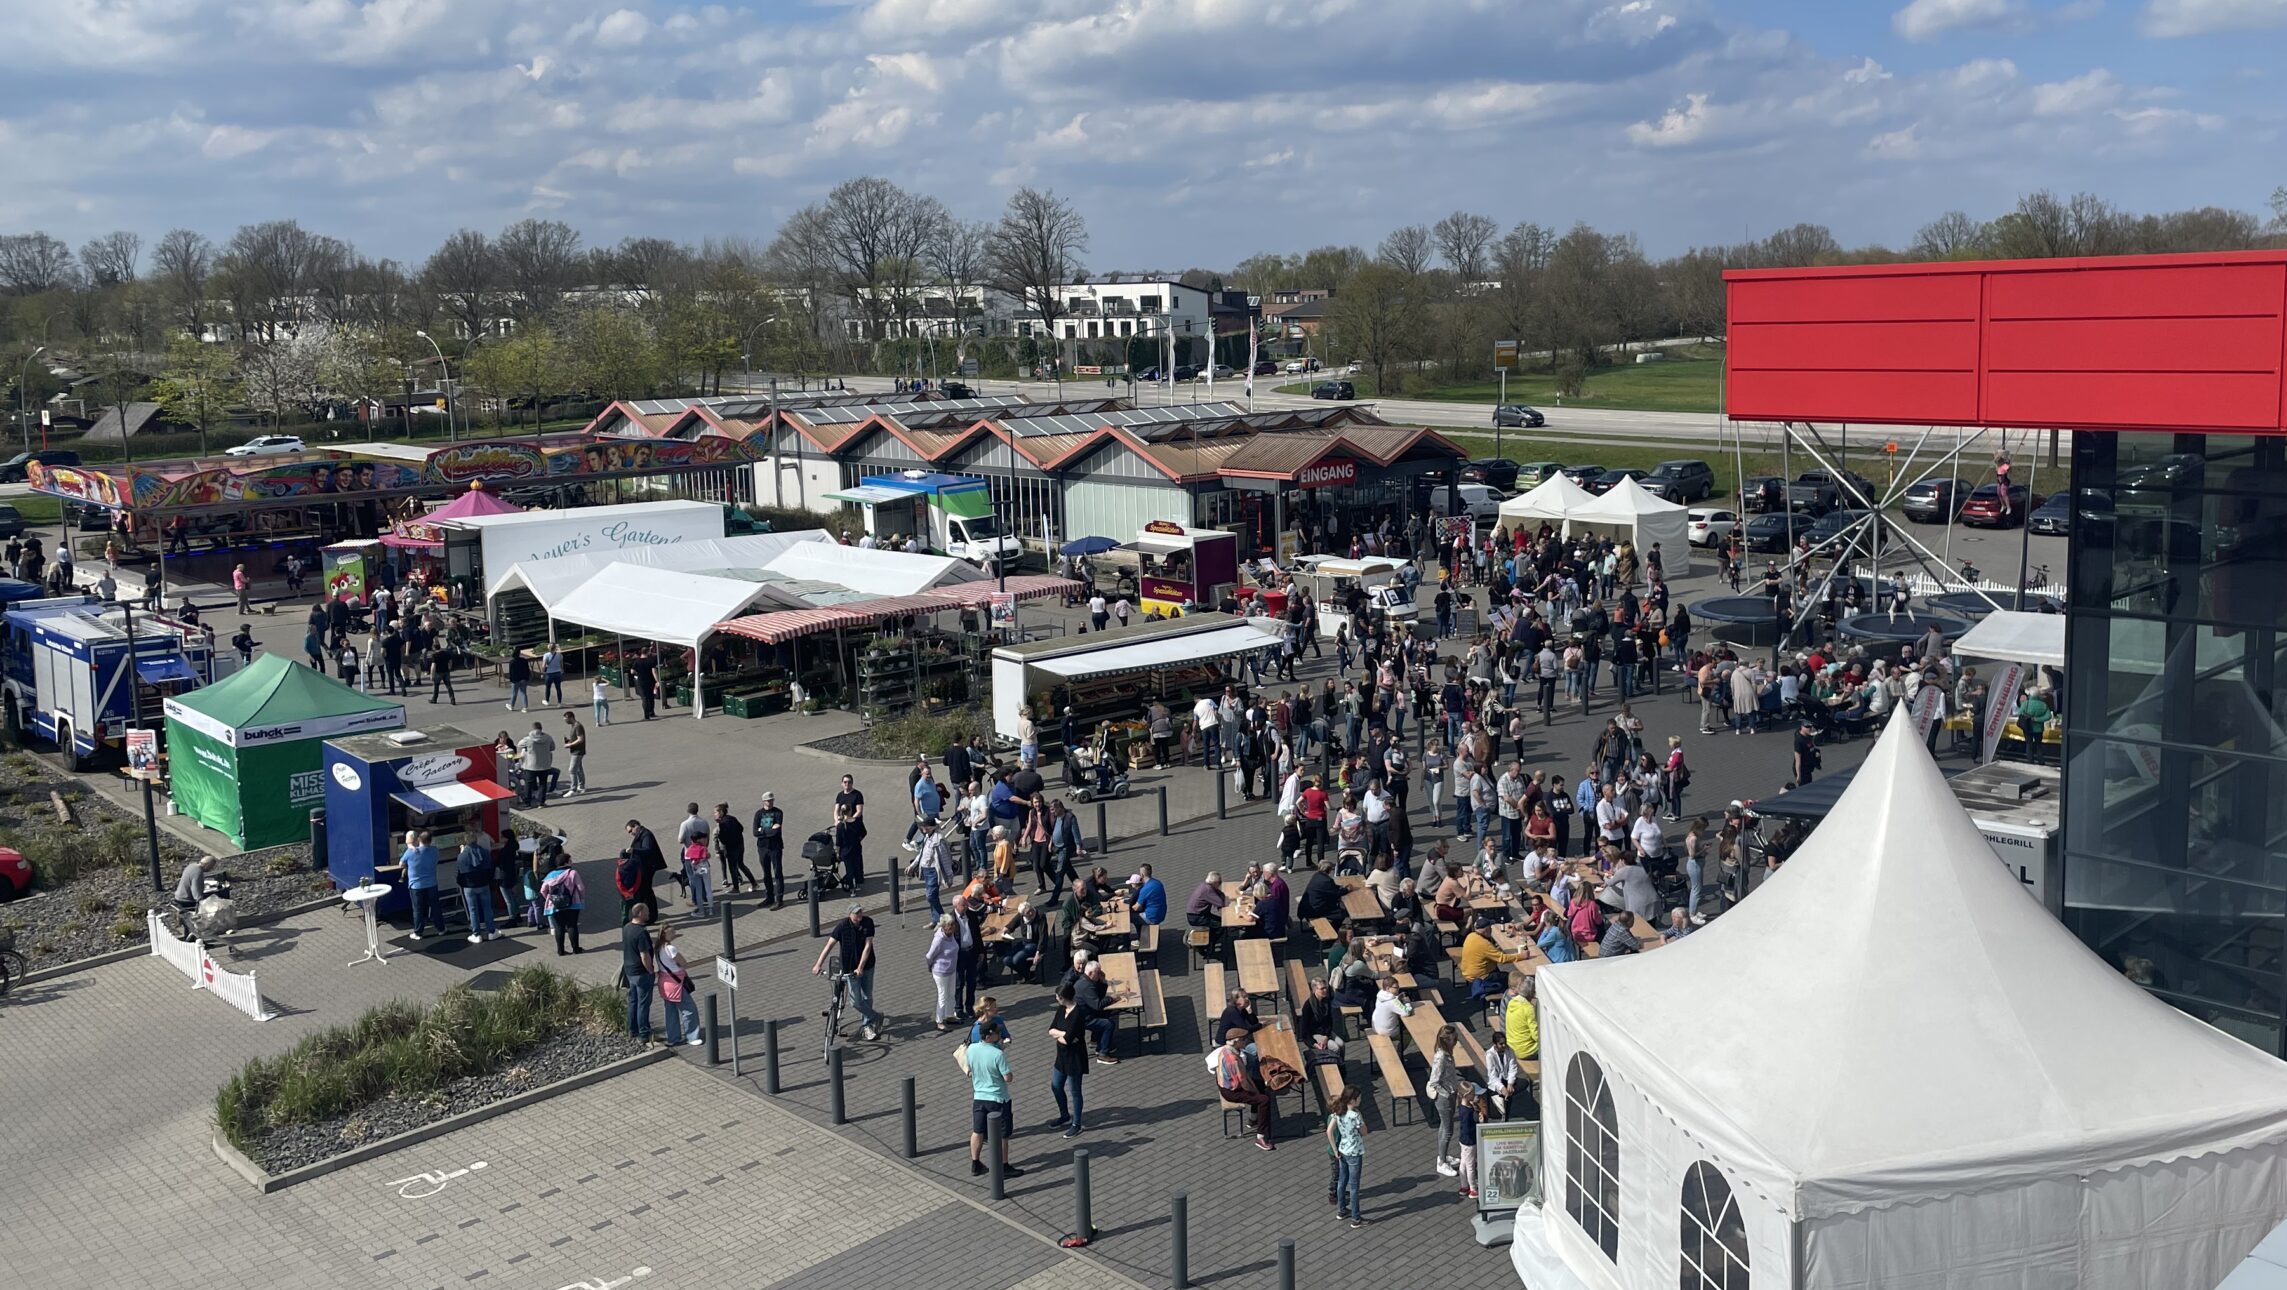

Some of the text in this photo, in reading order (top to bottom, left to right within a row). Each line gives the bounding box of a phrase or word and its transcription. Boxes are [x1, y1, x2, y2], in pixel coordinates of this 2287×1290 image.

[1300, 463, 1354, 483] EINGANG
[1986, 666, 2019, 738] SCHULENBURG
[244, 727, 284, 740] buhck
[421, 757, 463, 780] Factory
[1487, 1190, 1498, 1198] 22
